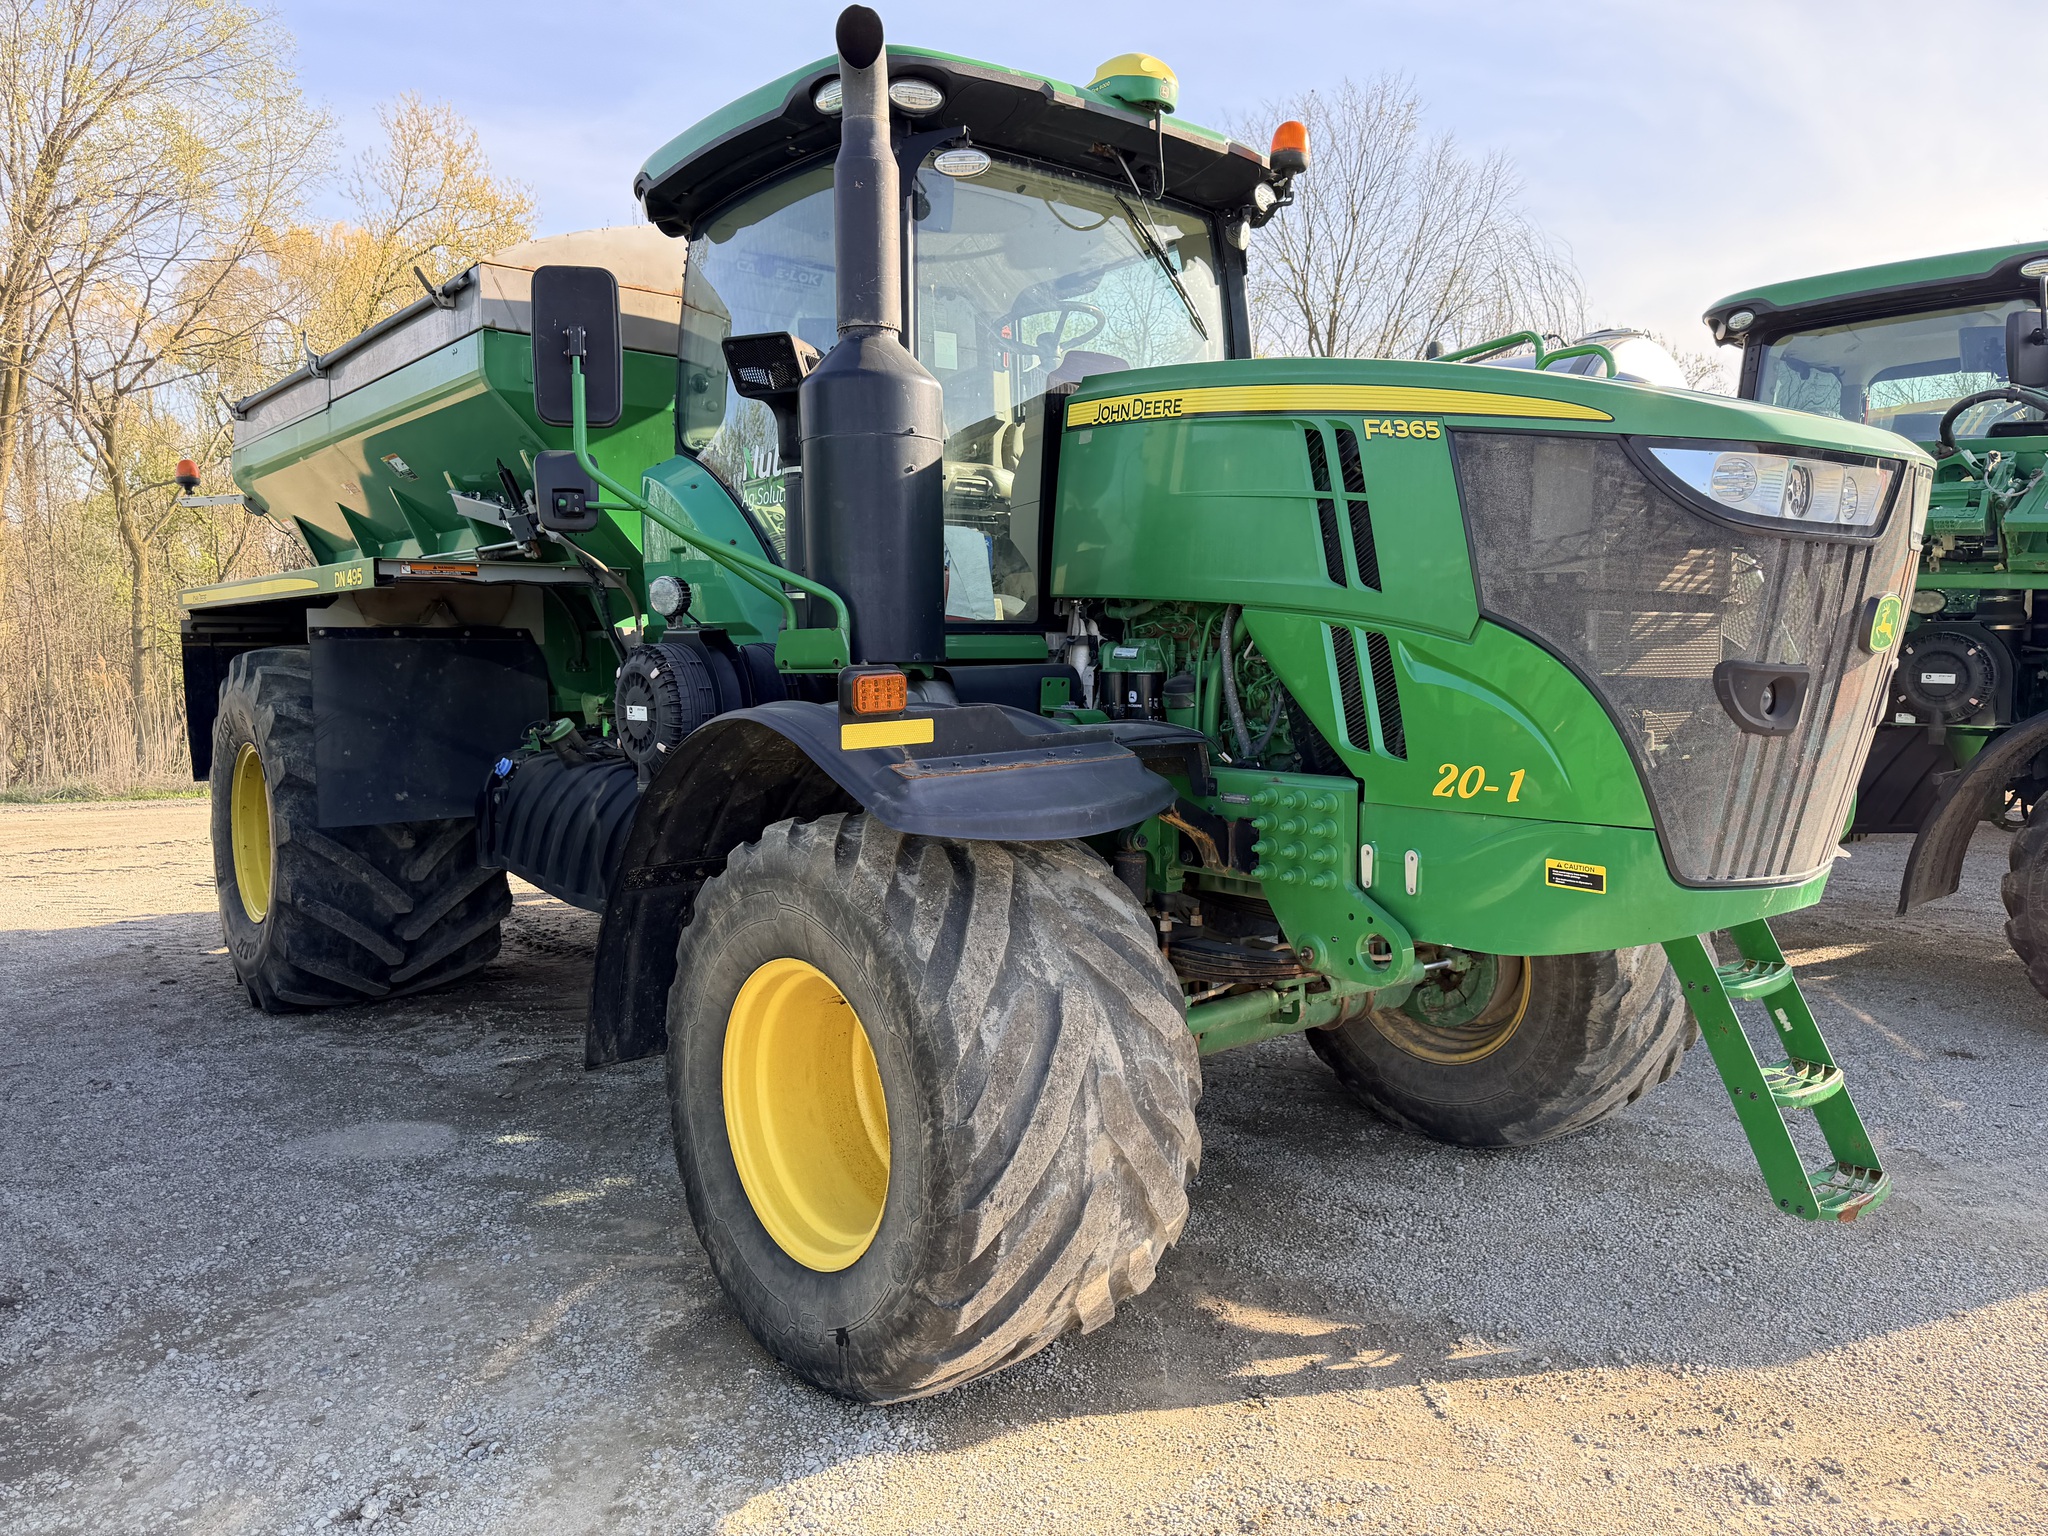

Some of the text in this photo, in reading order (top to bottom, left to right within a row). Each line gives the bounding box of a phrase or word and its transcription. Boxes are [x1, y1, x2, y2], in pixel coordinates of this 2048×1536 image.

[1092, 398, 1183, 423] JOHN DEERE
[1363, 418, 1441, 440] F4365
[741, 490, 755, 511] Ag
[334, 567, 363, 588] DN 495
[1563, 863, 1595, 873] CAUTION
